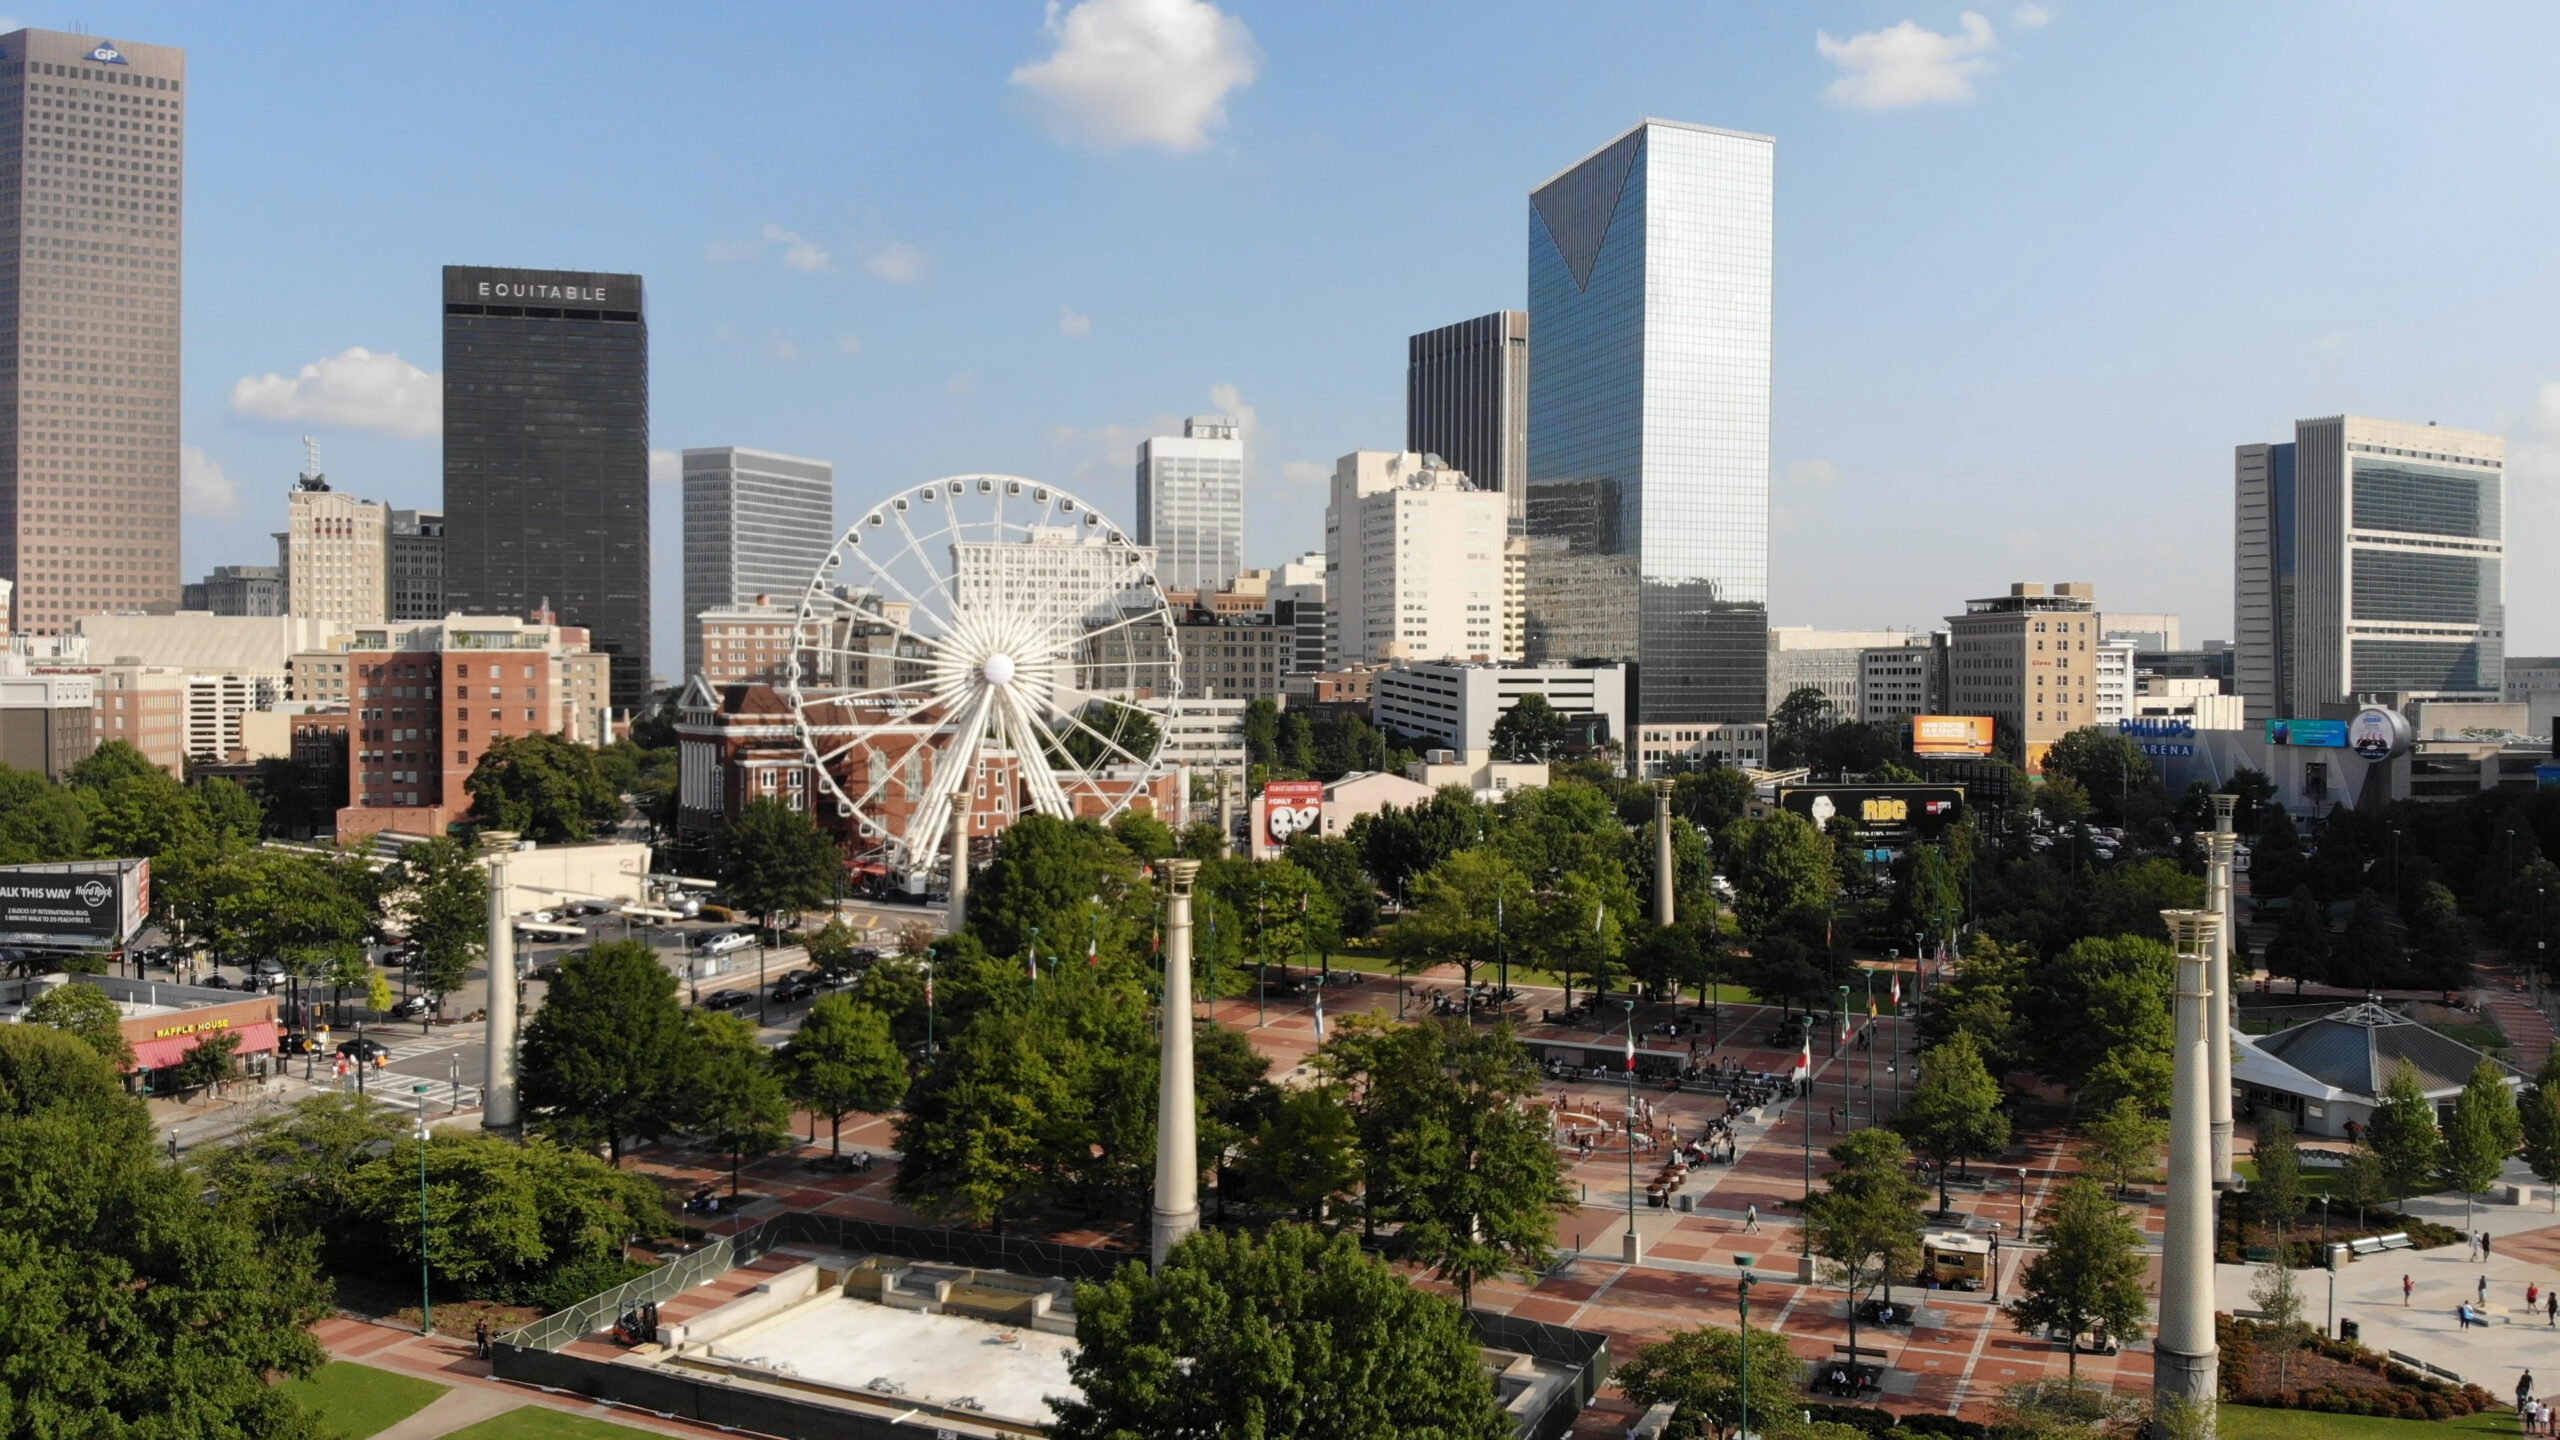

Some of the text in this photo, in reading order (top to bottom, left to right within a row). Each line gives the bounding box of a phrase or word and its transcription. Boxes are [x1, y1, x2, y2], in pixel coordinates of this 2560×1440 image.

[94, 48, 118, 60] GP
[479, 282, 606, 300] EQUITABLE
[2119, 718, 2195, 738] PHILIPS
[2141, 745, 2189, 755] ARENA
[1863, 800, 1906, 820] RBG
[20, 887, 44, 899] THIS
[45, 888, 71, 899] WAY
[75, 885, 112, 898] Hard Rock
[156, 1019, 229, 1037] WAFFLE HOUSE
